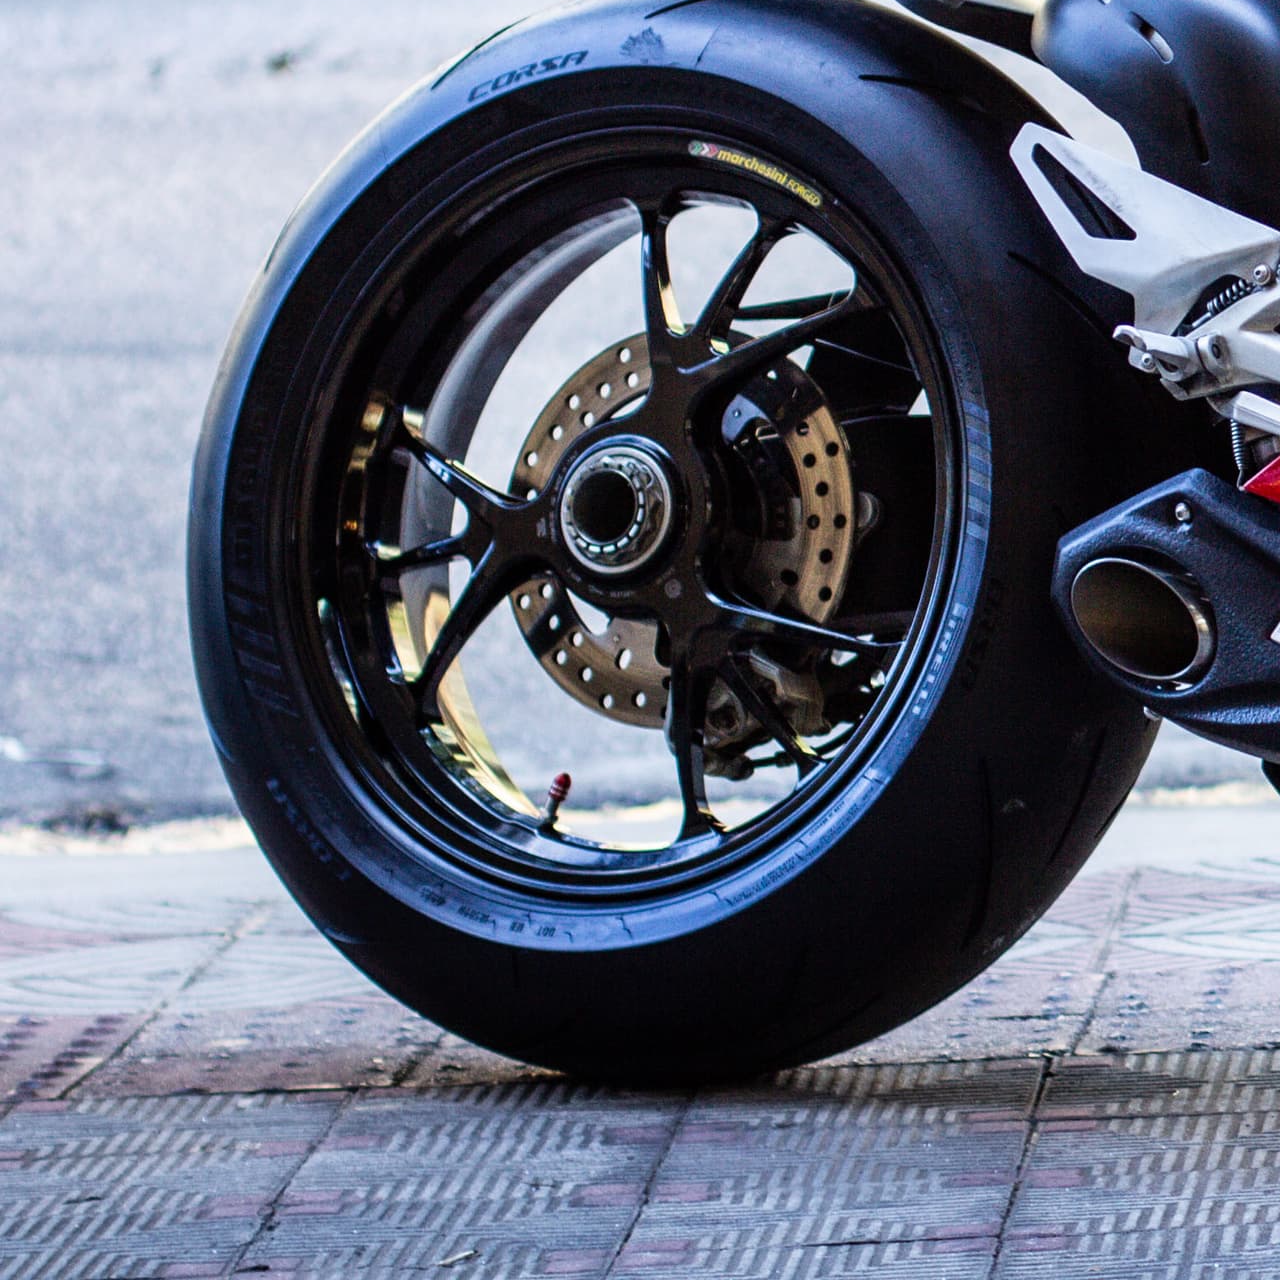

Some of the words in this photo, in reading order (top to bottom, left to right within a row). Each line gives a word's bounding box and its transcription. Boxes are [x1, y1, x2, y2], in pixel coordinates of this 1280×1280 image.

[467, 49, 588, 102] CORSA
[717, 149, 788, 185] marchesini
[786, 179, 820, 206] FORGED
